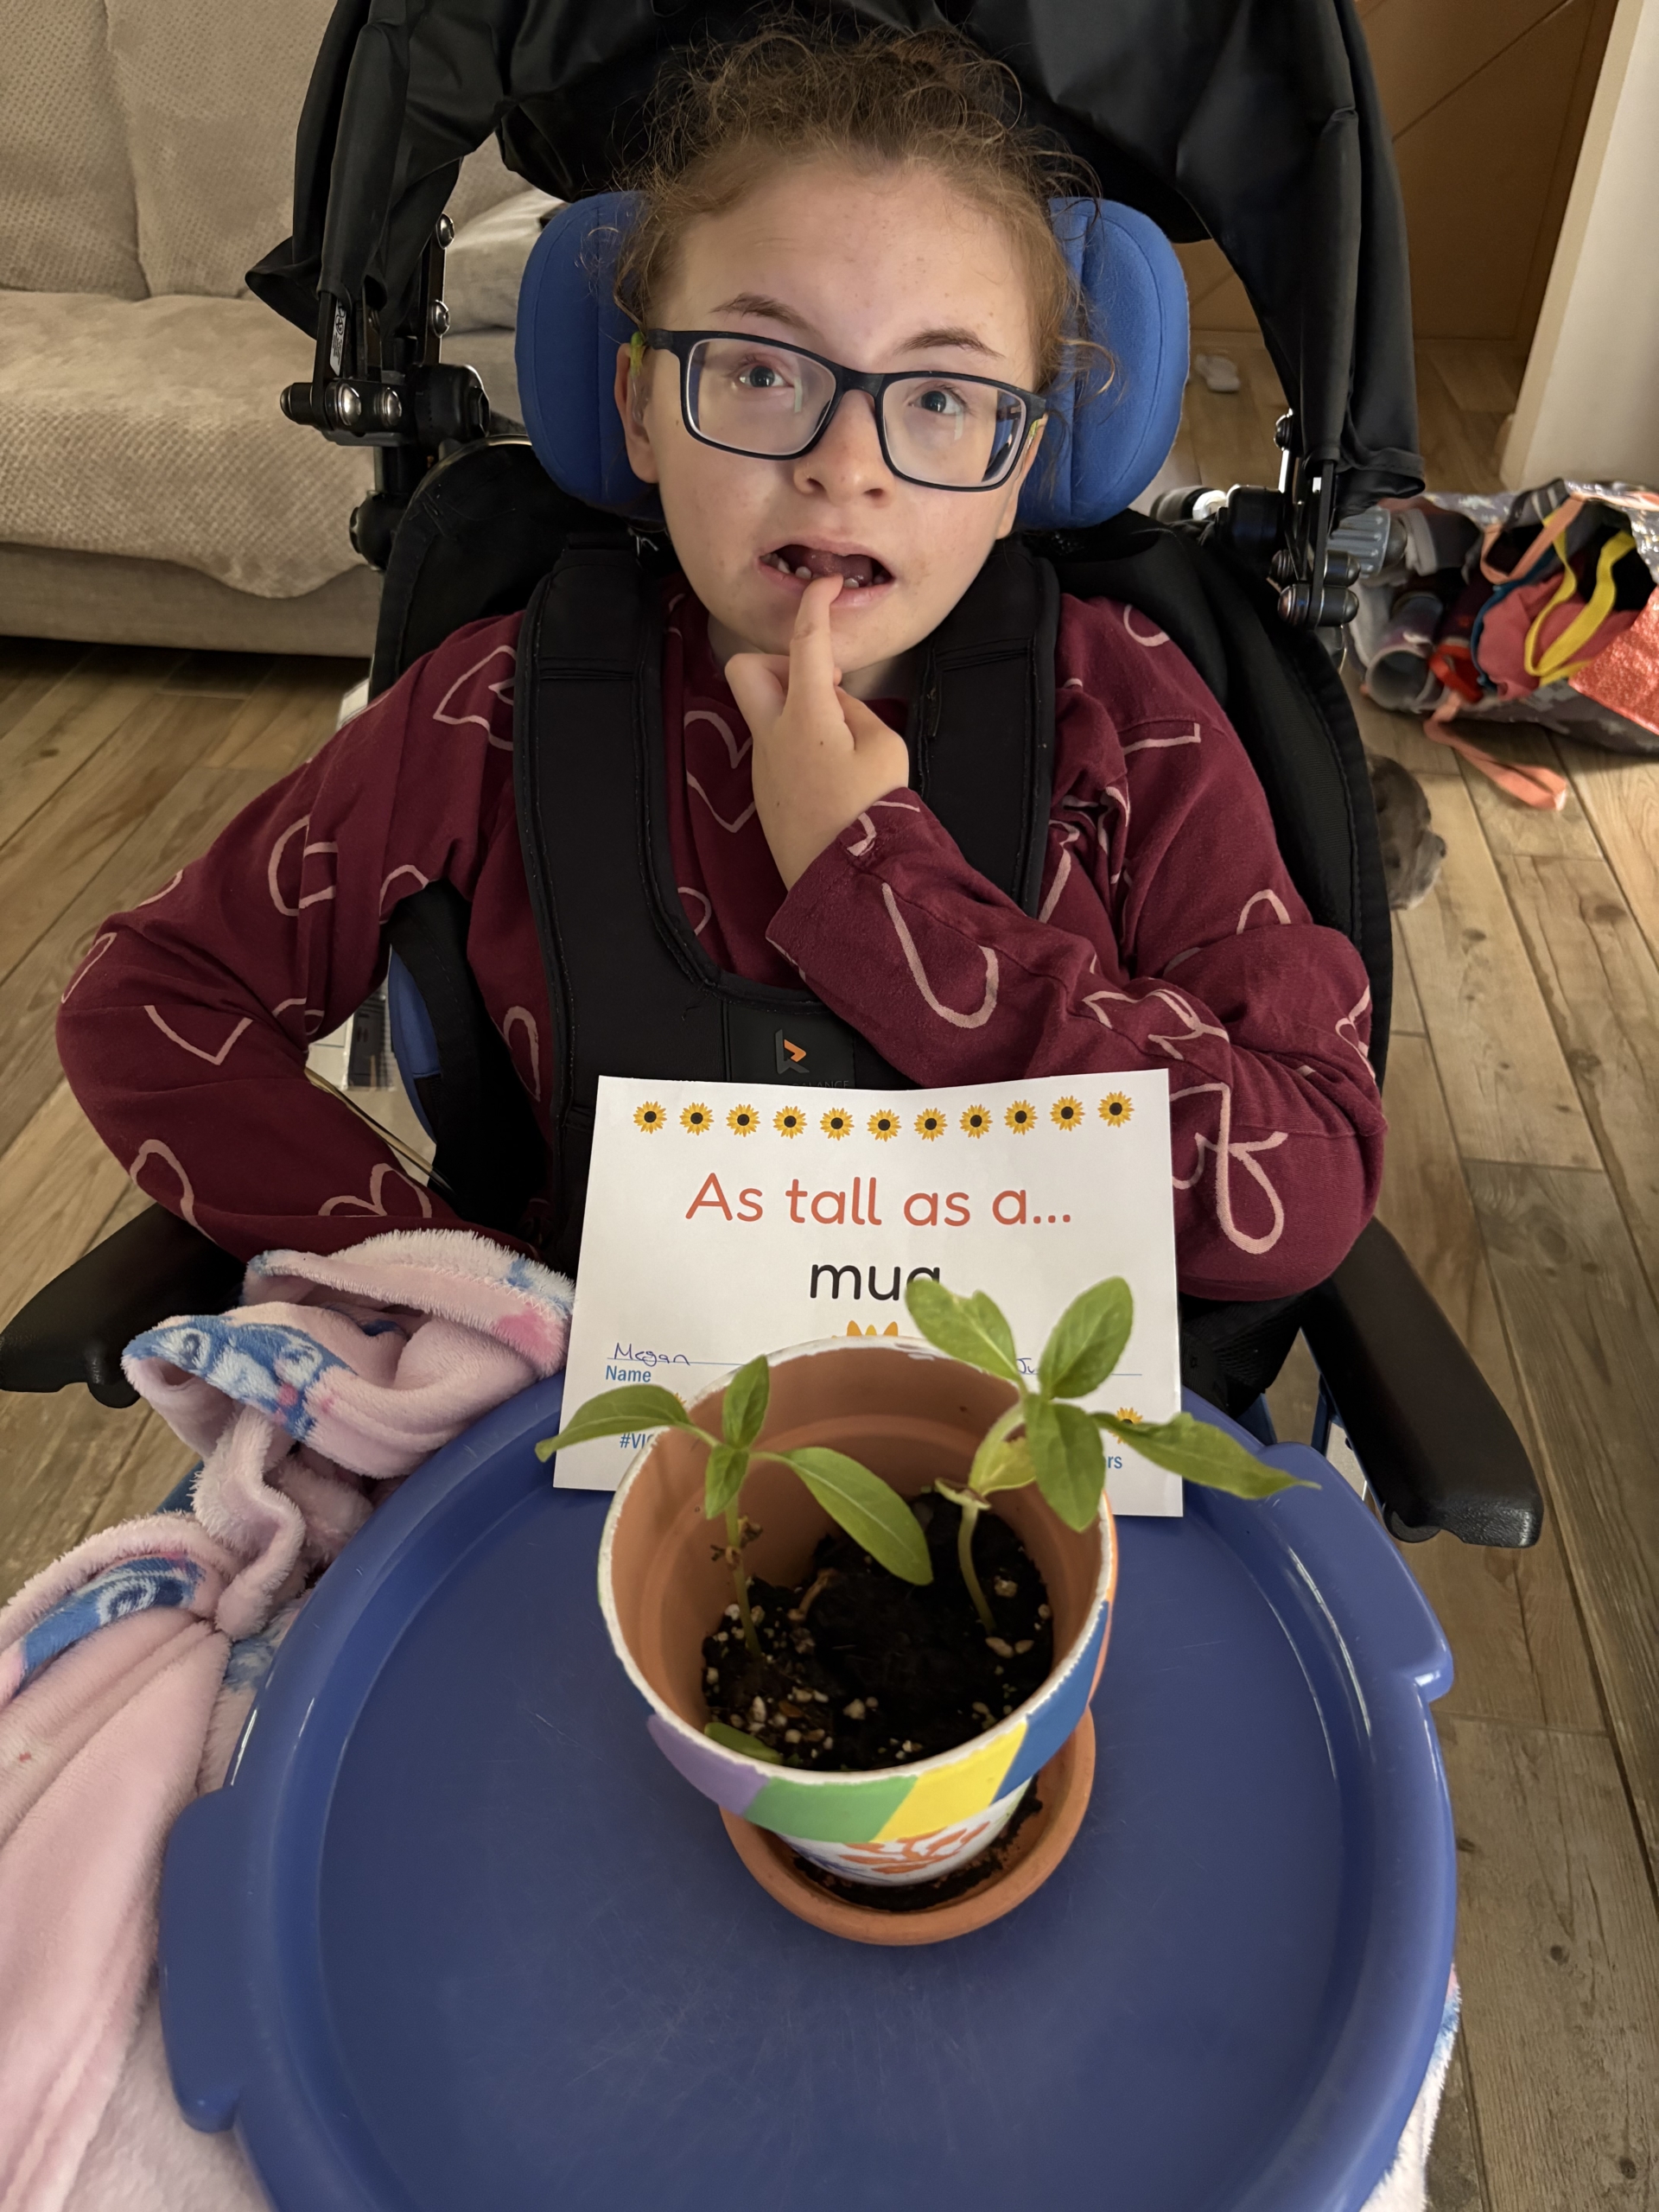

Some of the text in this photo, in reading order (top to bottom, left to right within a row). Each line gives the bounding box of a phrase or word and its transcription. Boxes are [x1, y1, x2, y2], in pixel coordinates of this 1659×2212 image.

[685, 1173, 1071, 1226] As tall as a...
[606, 1365, 652, 1382] Name
